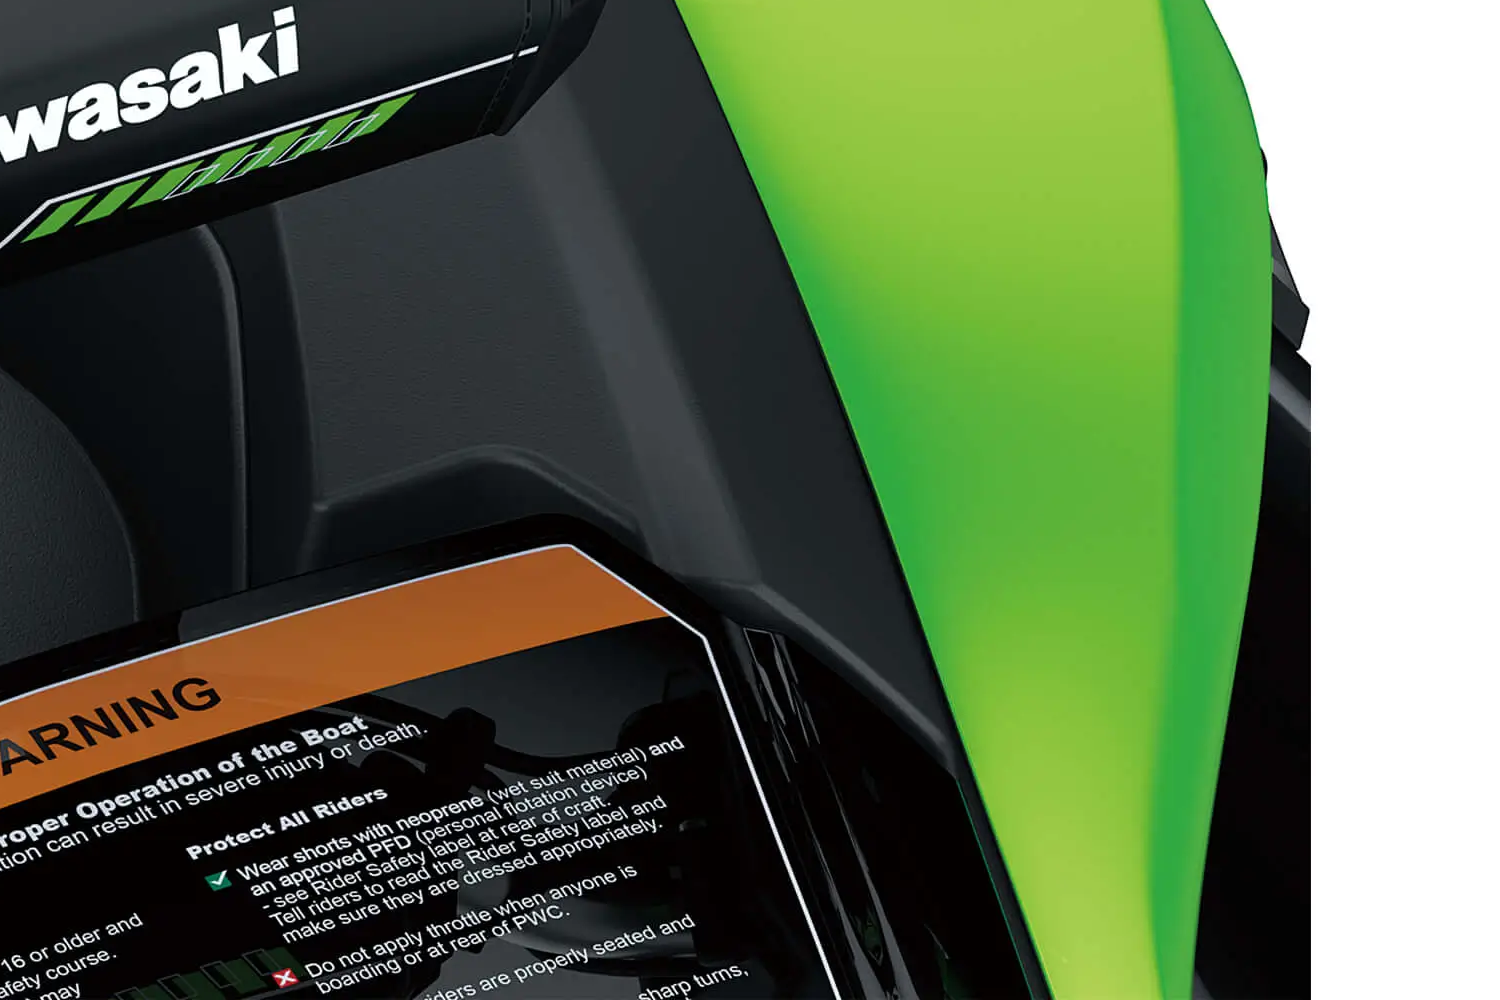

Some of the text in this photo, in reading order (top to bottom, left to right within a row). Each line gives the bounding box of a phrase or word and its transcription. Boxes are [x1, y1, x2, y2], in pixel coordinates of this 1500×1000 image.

[46, 831, 89, 852] can
[92, 805, 157, 837] result
[157, 799, 182, 815] in
[185, 774, 261, 805] severe
[262, 752, 324, 780] injury
[330, 743, 352, 759] or
[358, 723, 427, 751] death.
[76, 768, 212, 818] Operation
[218, 752, 245, 773] of
[251, 741, 297, 762] the
[300, 716, 369, 746] Boat
[236, 736, 685, 880] Wear shorts with neoprene (wet suit material) and
[186, 789, 388, 860] Protect All Riders
[250, 765, 647, 896] an approved PFD (personal flotation device)
[268, 795, 667, 926] Tell riders to read the Rider Safety label and
[274, 889, 309, 908] see
[310, 870, 362, 895] Rider
[365, 851, 426, 877] Safety
[427, 833, 476, 858] label
[478, 827, 499, 842] at
[500, 816, 537, 836] rear
[542, 807, 561, 823] of
[564, 795, 611, 817] craft.
[282, 819, 663, 943] make sure they are dressed appropriately.
[305, 866, 637, 978] Do not apply throttle when anyone is
[1, 954, 26, 972] 16
[29, 947, 49, 962] or
[54, 929, 101, 954] older
[105, 912, 143, 936] and
[40, 983, 80, 1000] may
[46, 950, 117, 980] course.
[315, 905, 570, 994] boarding or at rear of PWC.
[424, 914, 695, 1000] ders are properly seated and
[638, 966, 749, 1000] sharp turns,
